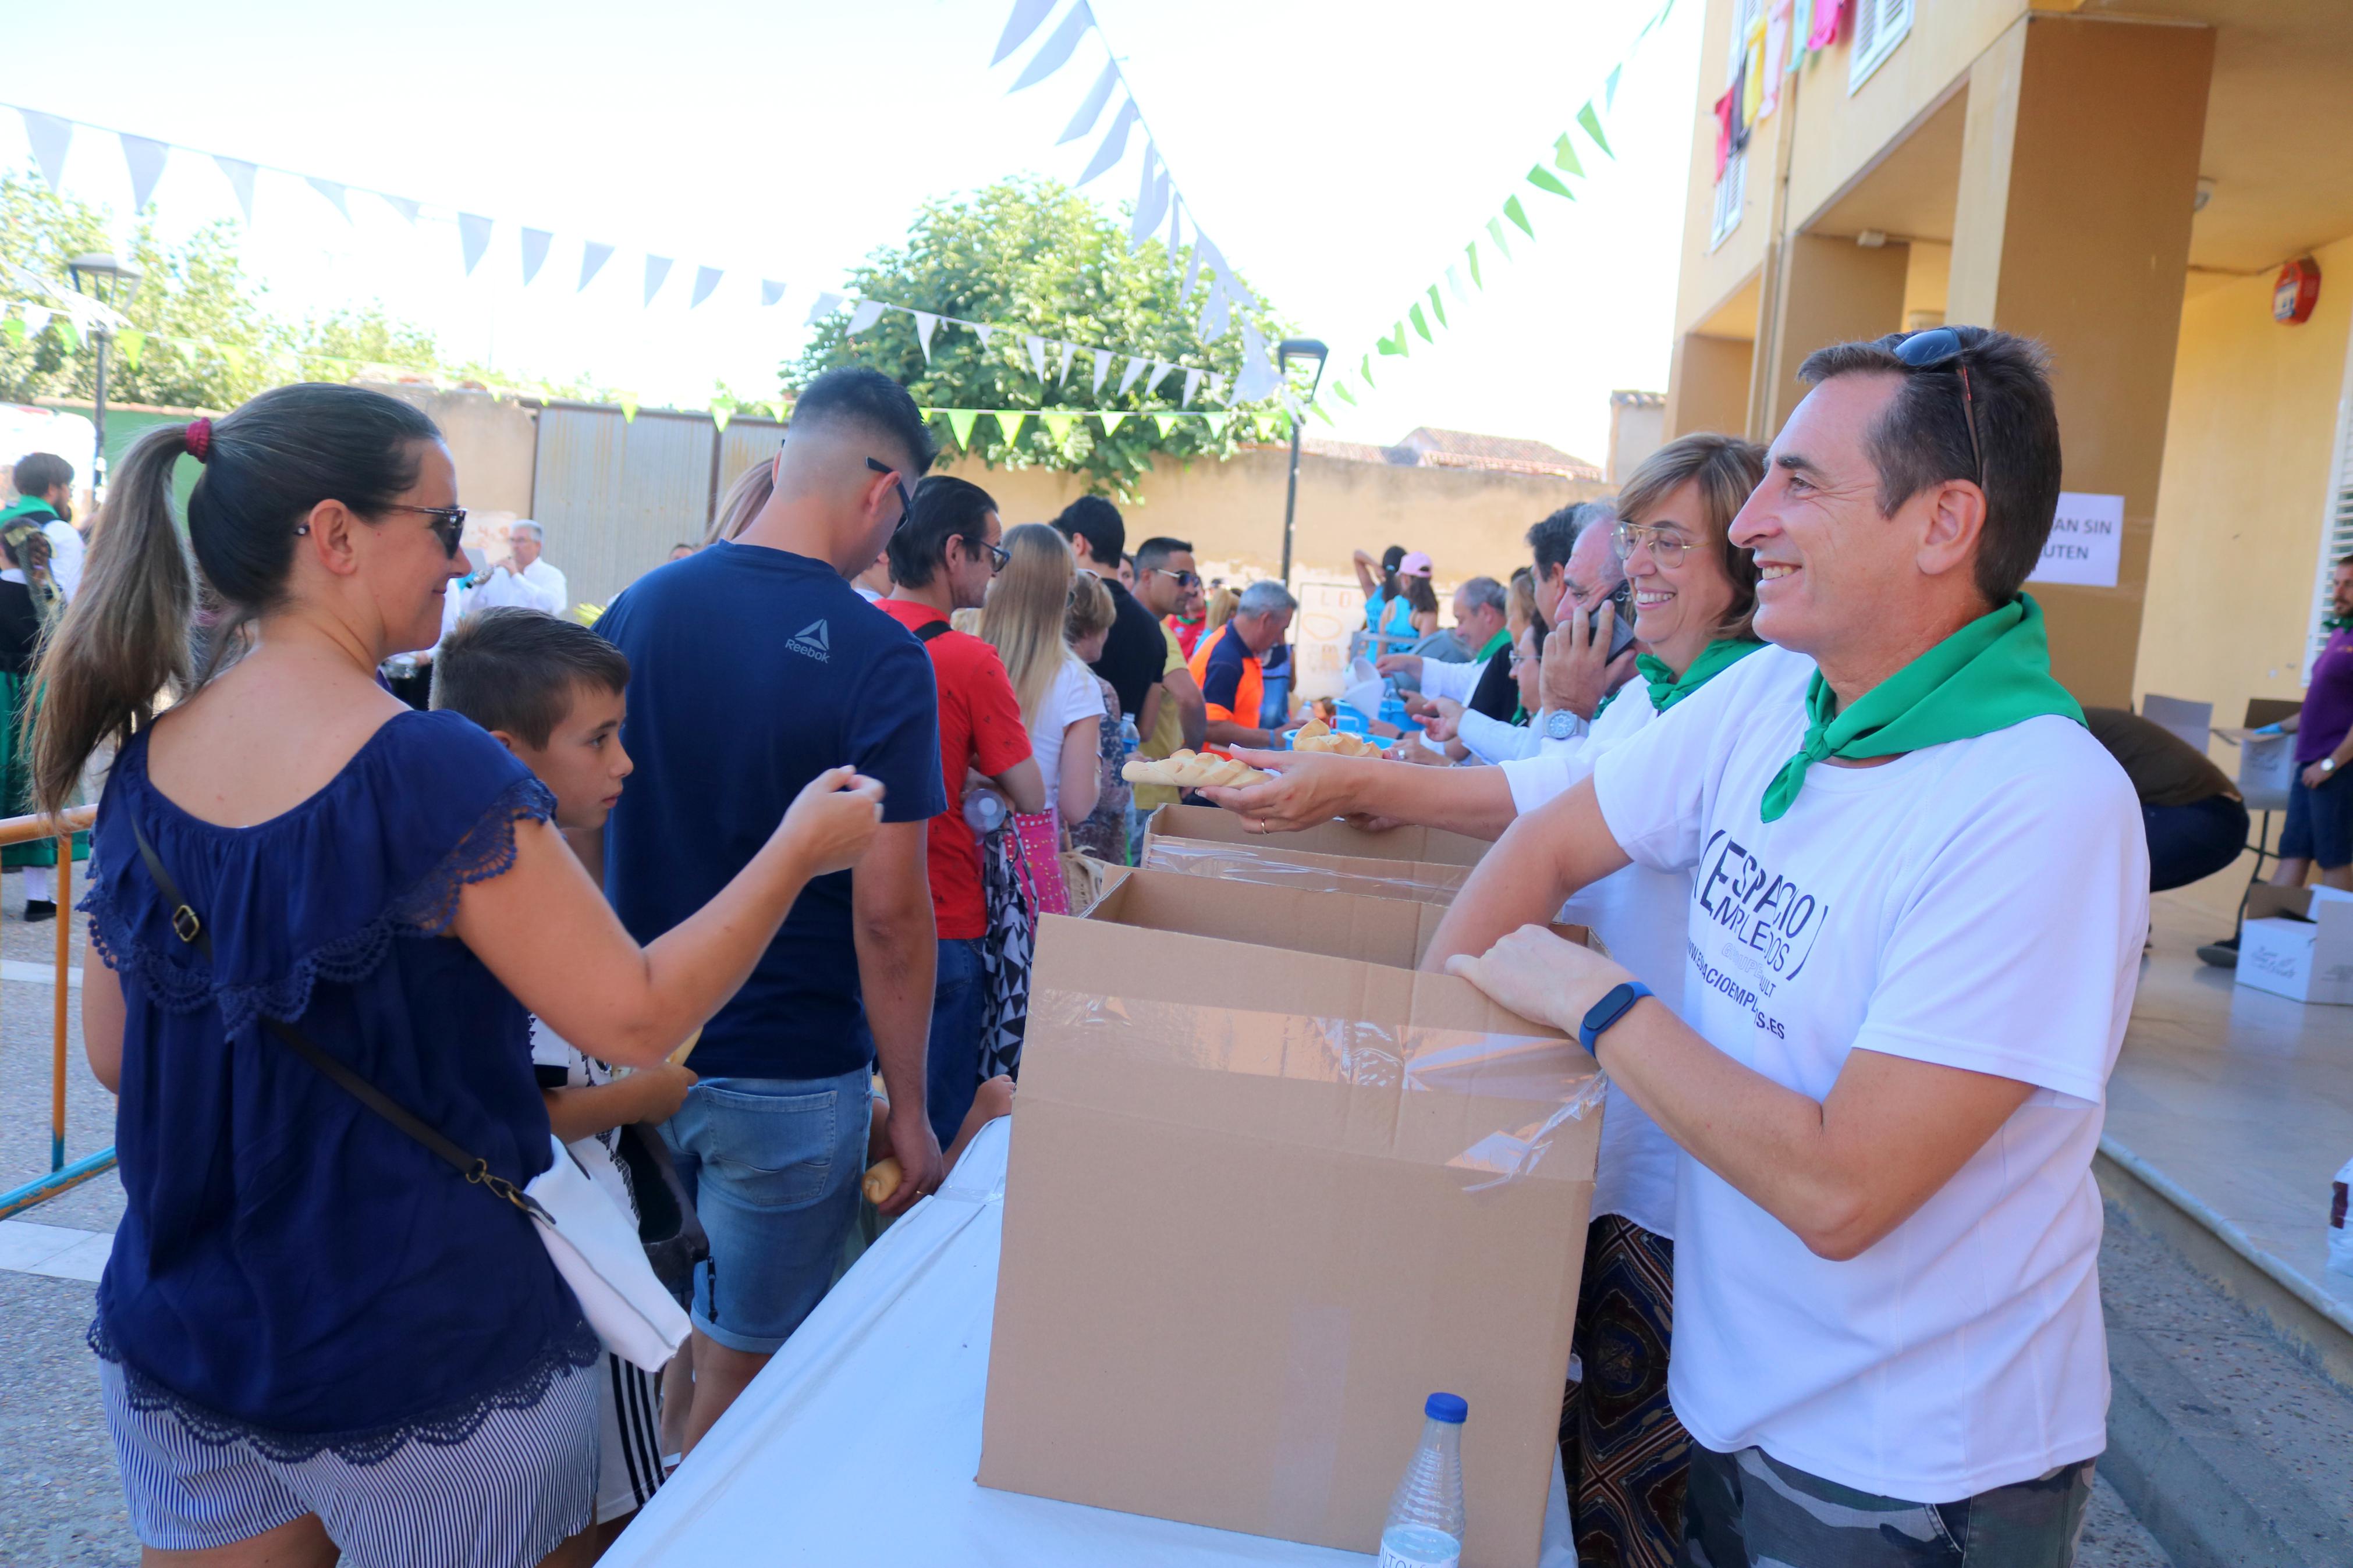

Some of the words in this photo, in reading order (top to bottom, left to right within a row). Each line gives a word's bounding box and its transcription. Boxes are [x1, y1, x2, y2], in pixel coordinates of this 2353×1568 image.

[2052, 518, 2079, 532] AN
[2084, 519, 2113, 535] SIN
[2042, 545, 2089, 560] UTEN
[785, 639, 831, 664] Reebok
